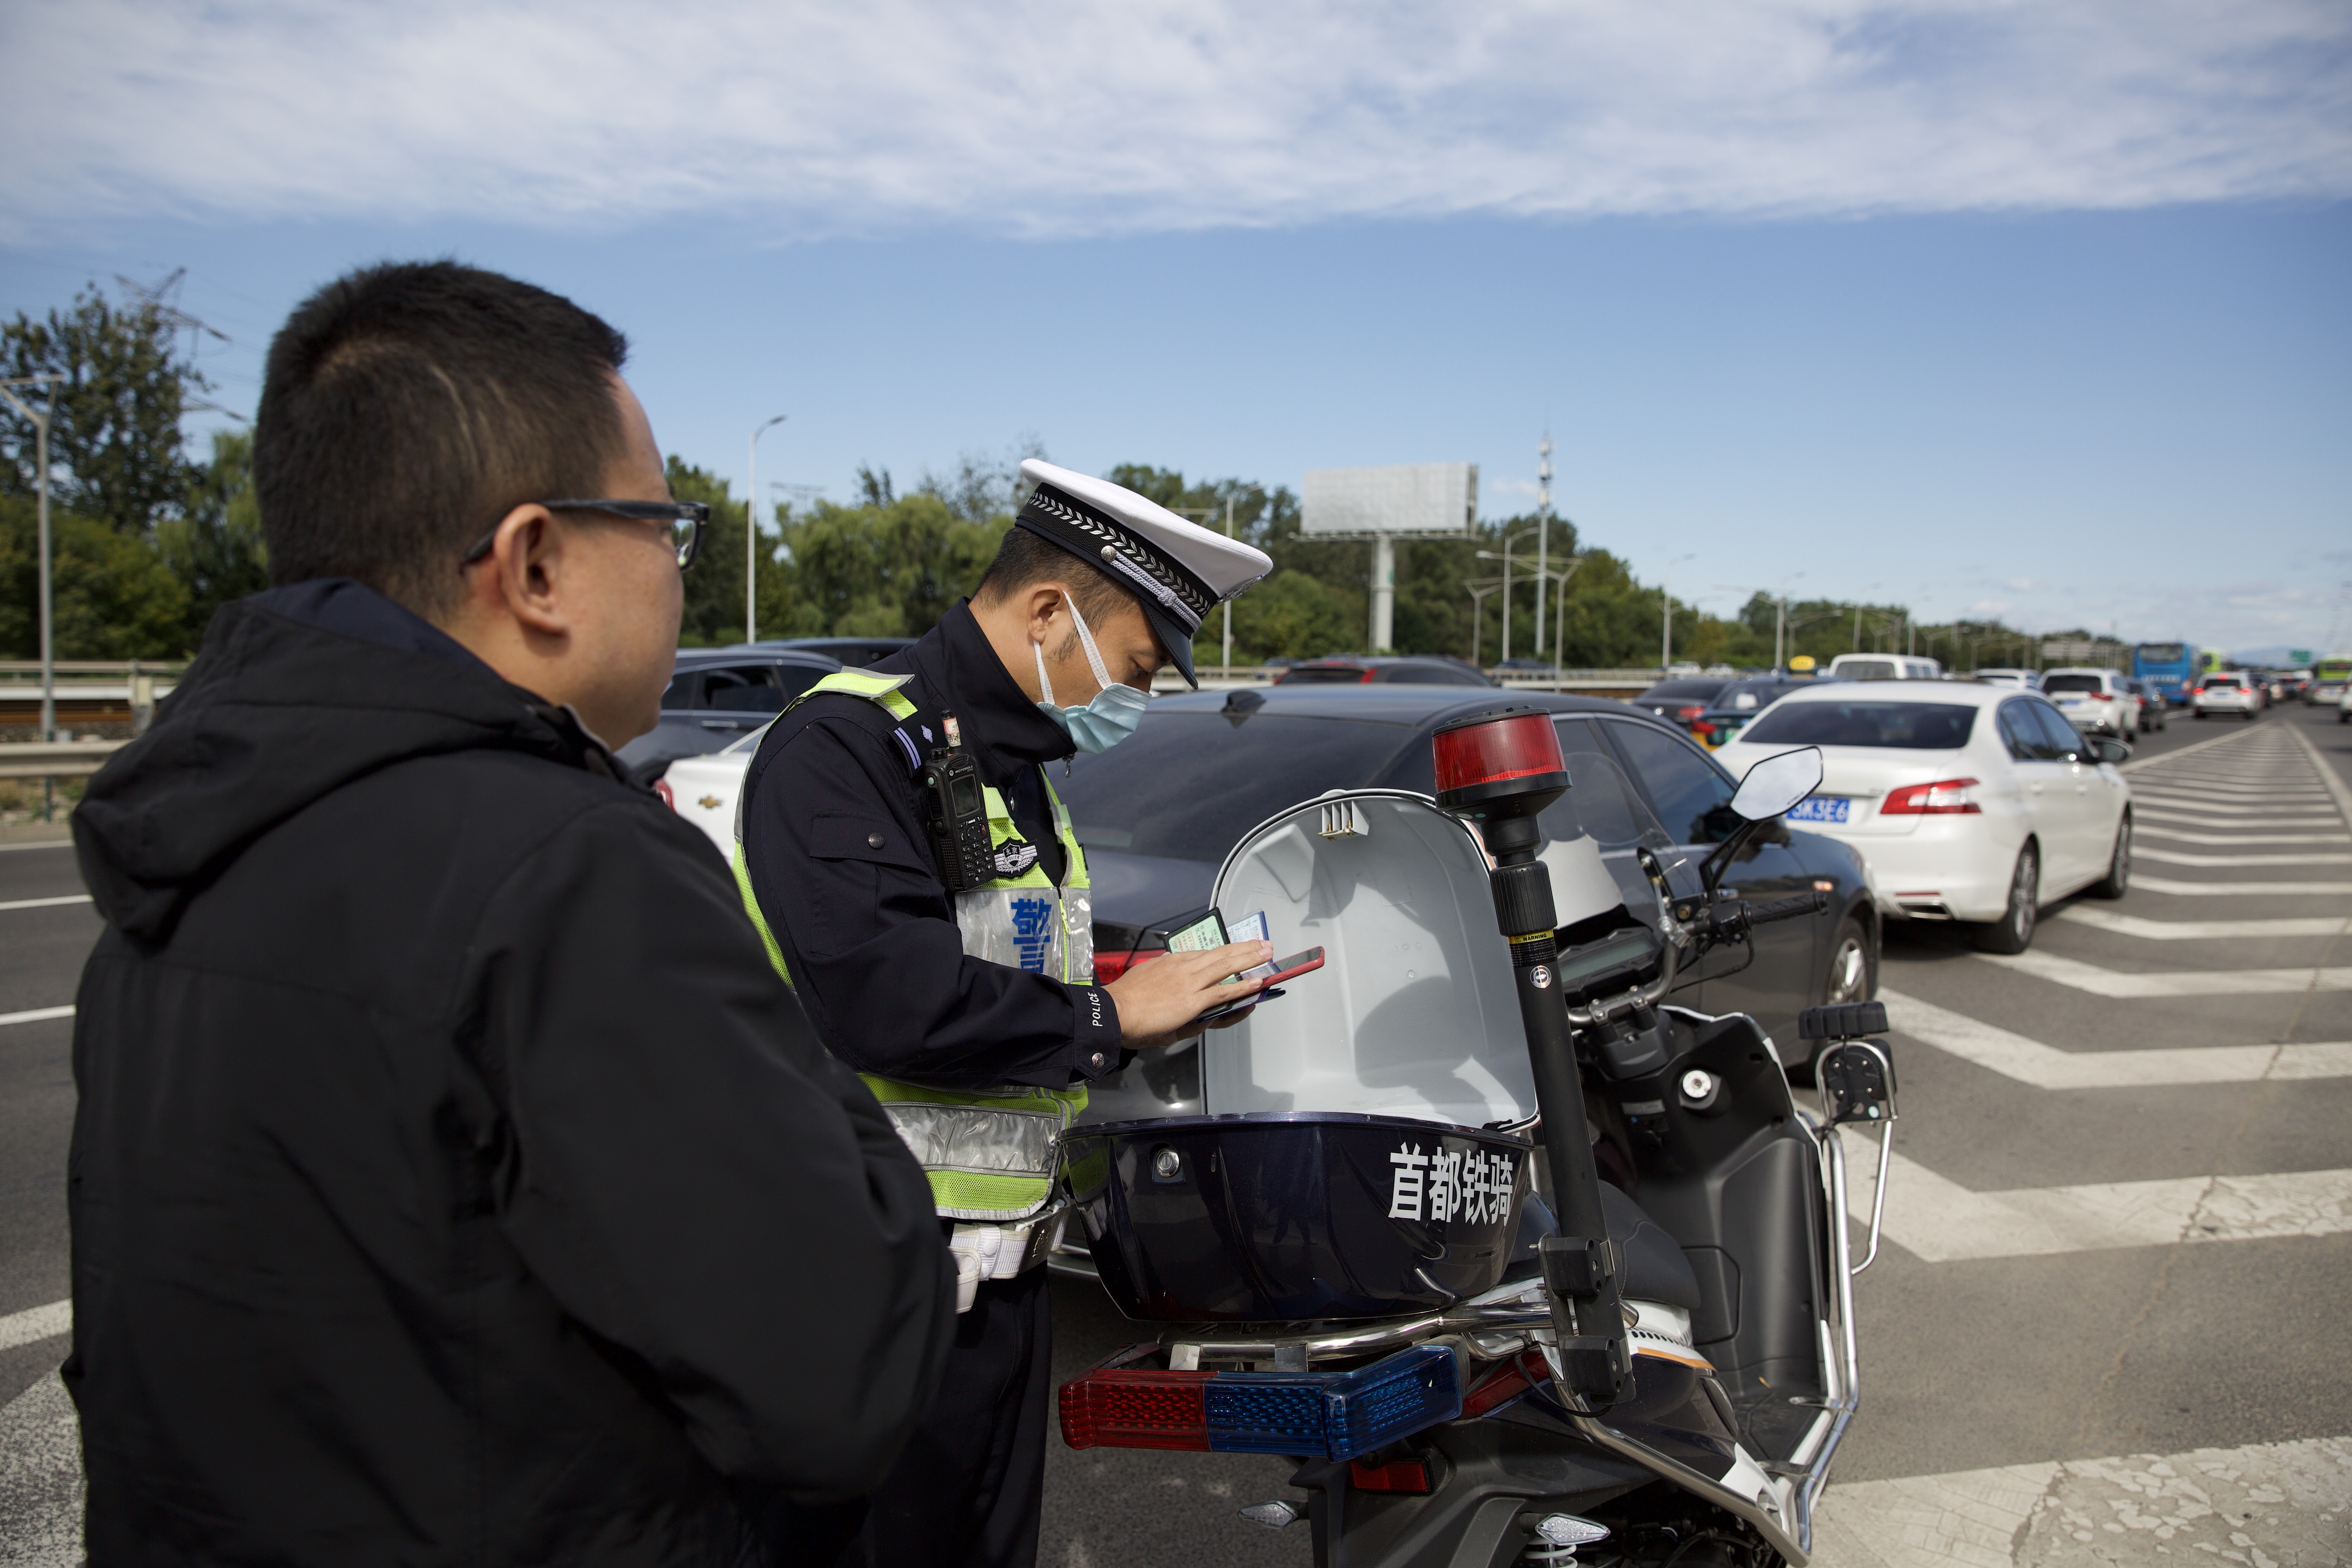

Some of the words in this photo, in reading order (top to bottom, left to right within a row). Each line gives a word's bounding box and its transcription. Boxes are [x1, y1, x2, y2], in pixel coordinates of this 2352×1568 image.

[956, 765, 973, 773] MOTOROLA
[1006, 847, 1017, 855] 北京
[1087, 992, 1103, 1027] POLICE
[1388, 1141, 1513, 1226] 首都铁骑
